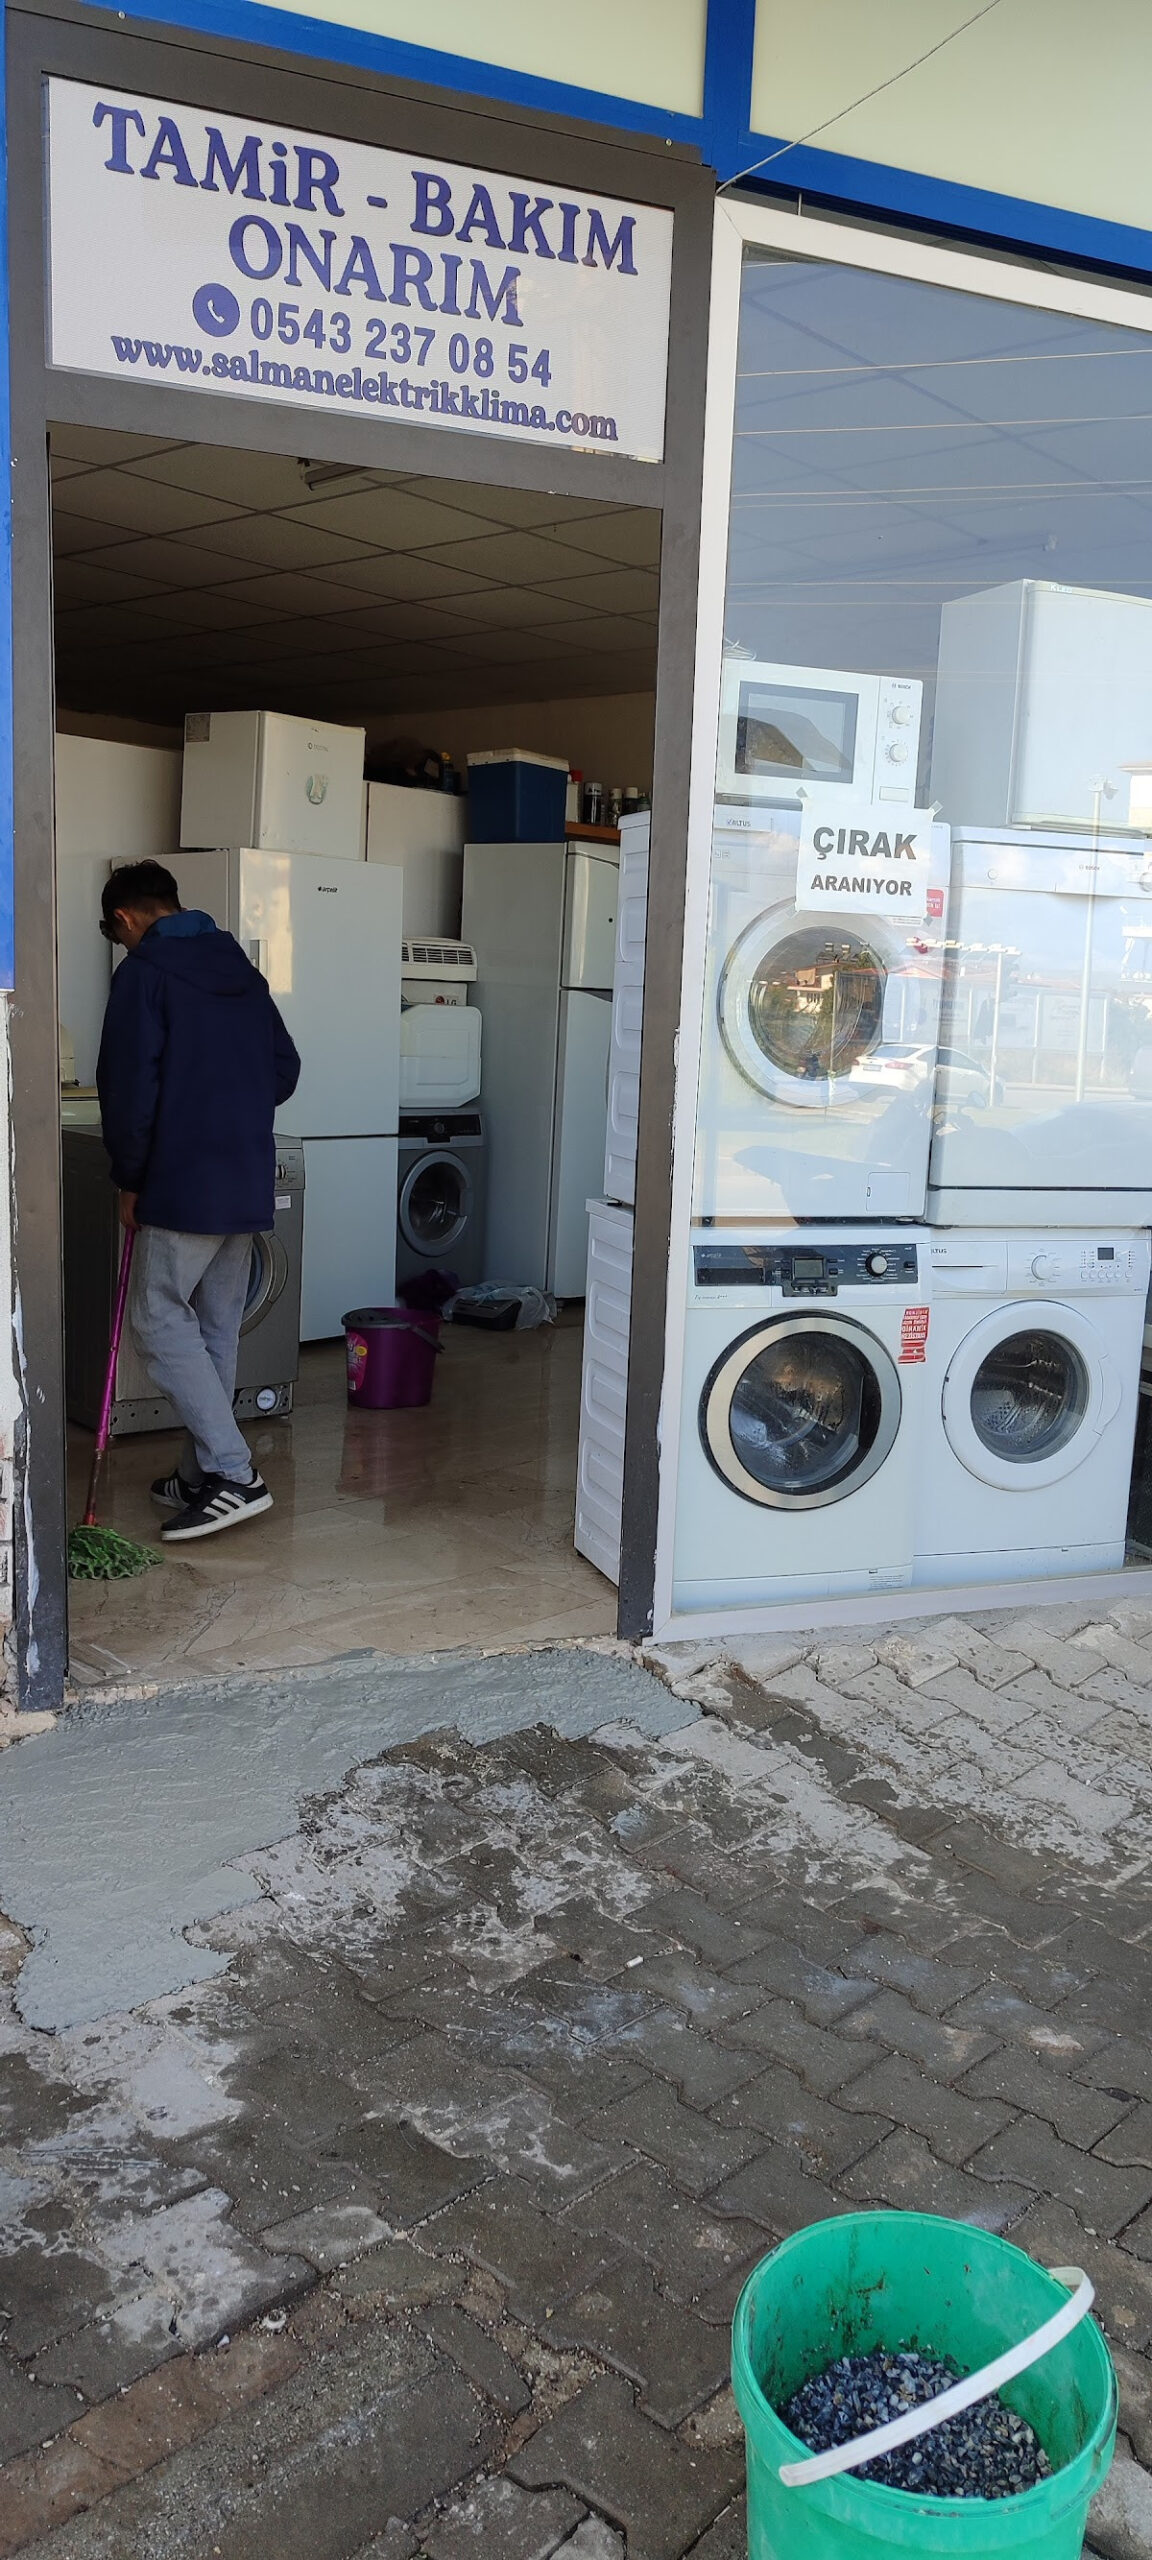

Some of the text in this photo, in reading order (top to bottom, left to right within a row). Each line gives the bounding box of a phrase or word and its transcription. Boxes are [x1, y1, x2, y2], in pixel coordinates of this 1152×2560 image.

[228, 214, 524, 328] ONARIM
[410, 170, 639, 276] BAKIM
[110, 335, 619, 441] www.salmanelektrikklima.com
[250, 297, 552, 388] 0543 237 08 54
[810, 874, 912, 897] ARANIYOR
[812, 826, 918, 861] ÇIRAK
